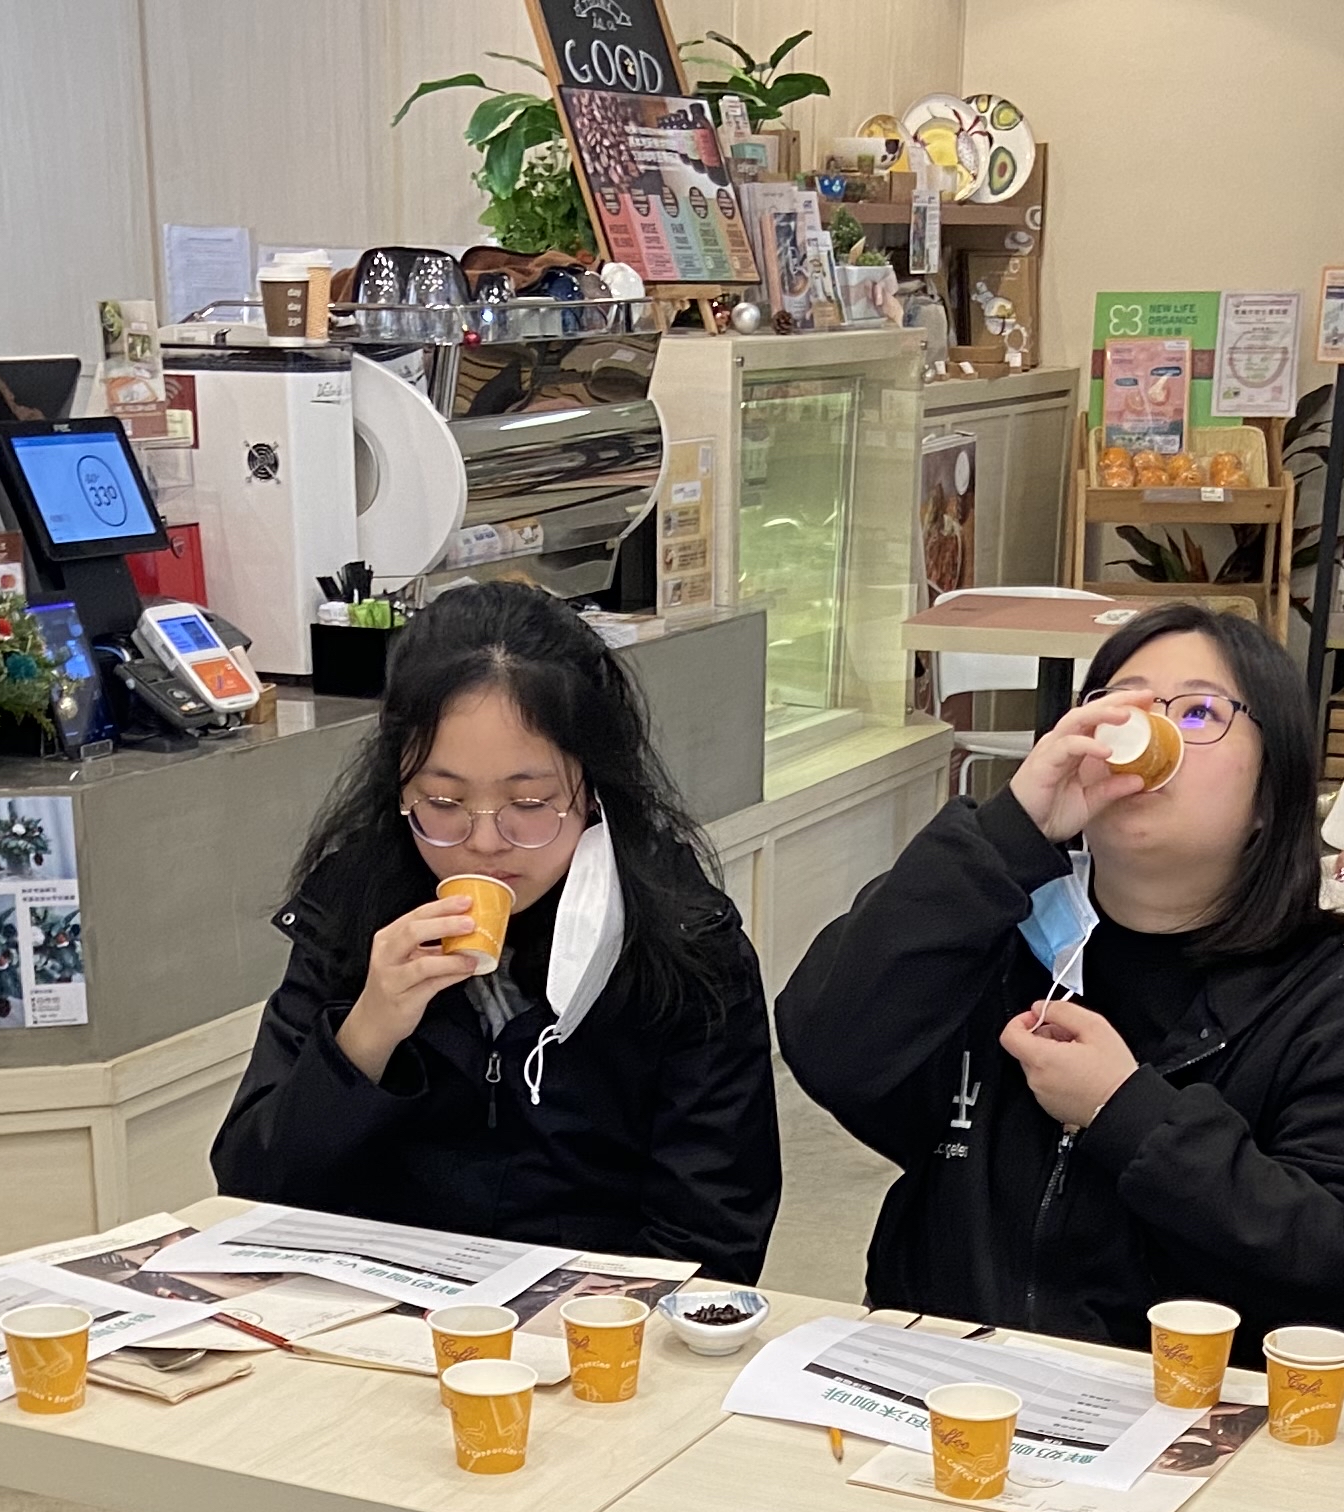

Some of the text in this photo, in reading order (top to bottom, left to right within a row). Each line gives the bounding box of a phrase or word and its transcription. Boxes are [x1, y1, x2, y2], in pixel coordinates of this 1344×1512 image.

[564, 39, 663, 93] GOOD
[1147, 315, 1198, 325] ORGANICS
[1149, 303, 1197, 314] NEW LIFE
[439, 1334, 484, 1364] Coff
[1155, 1332, 1194, 1365] Coffee
[1010, 1442, 1097, 1466] 鮮奶咖
[946, 1457, 975, 1483] Coffee
